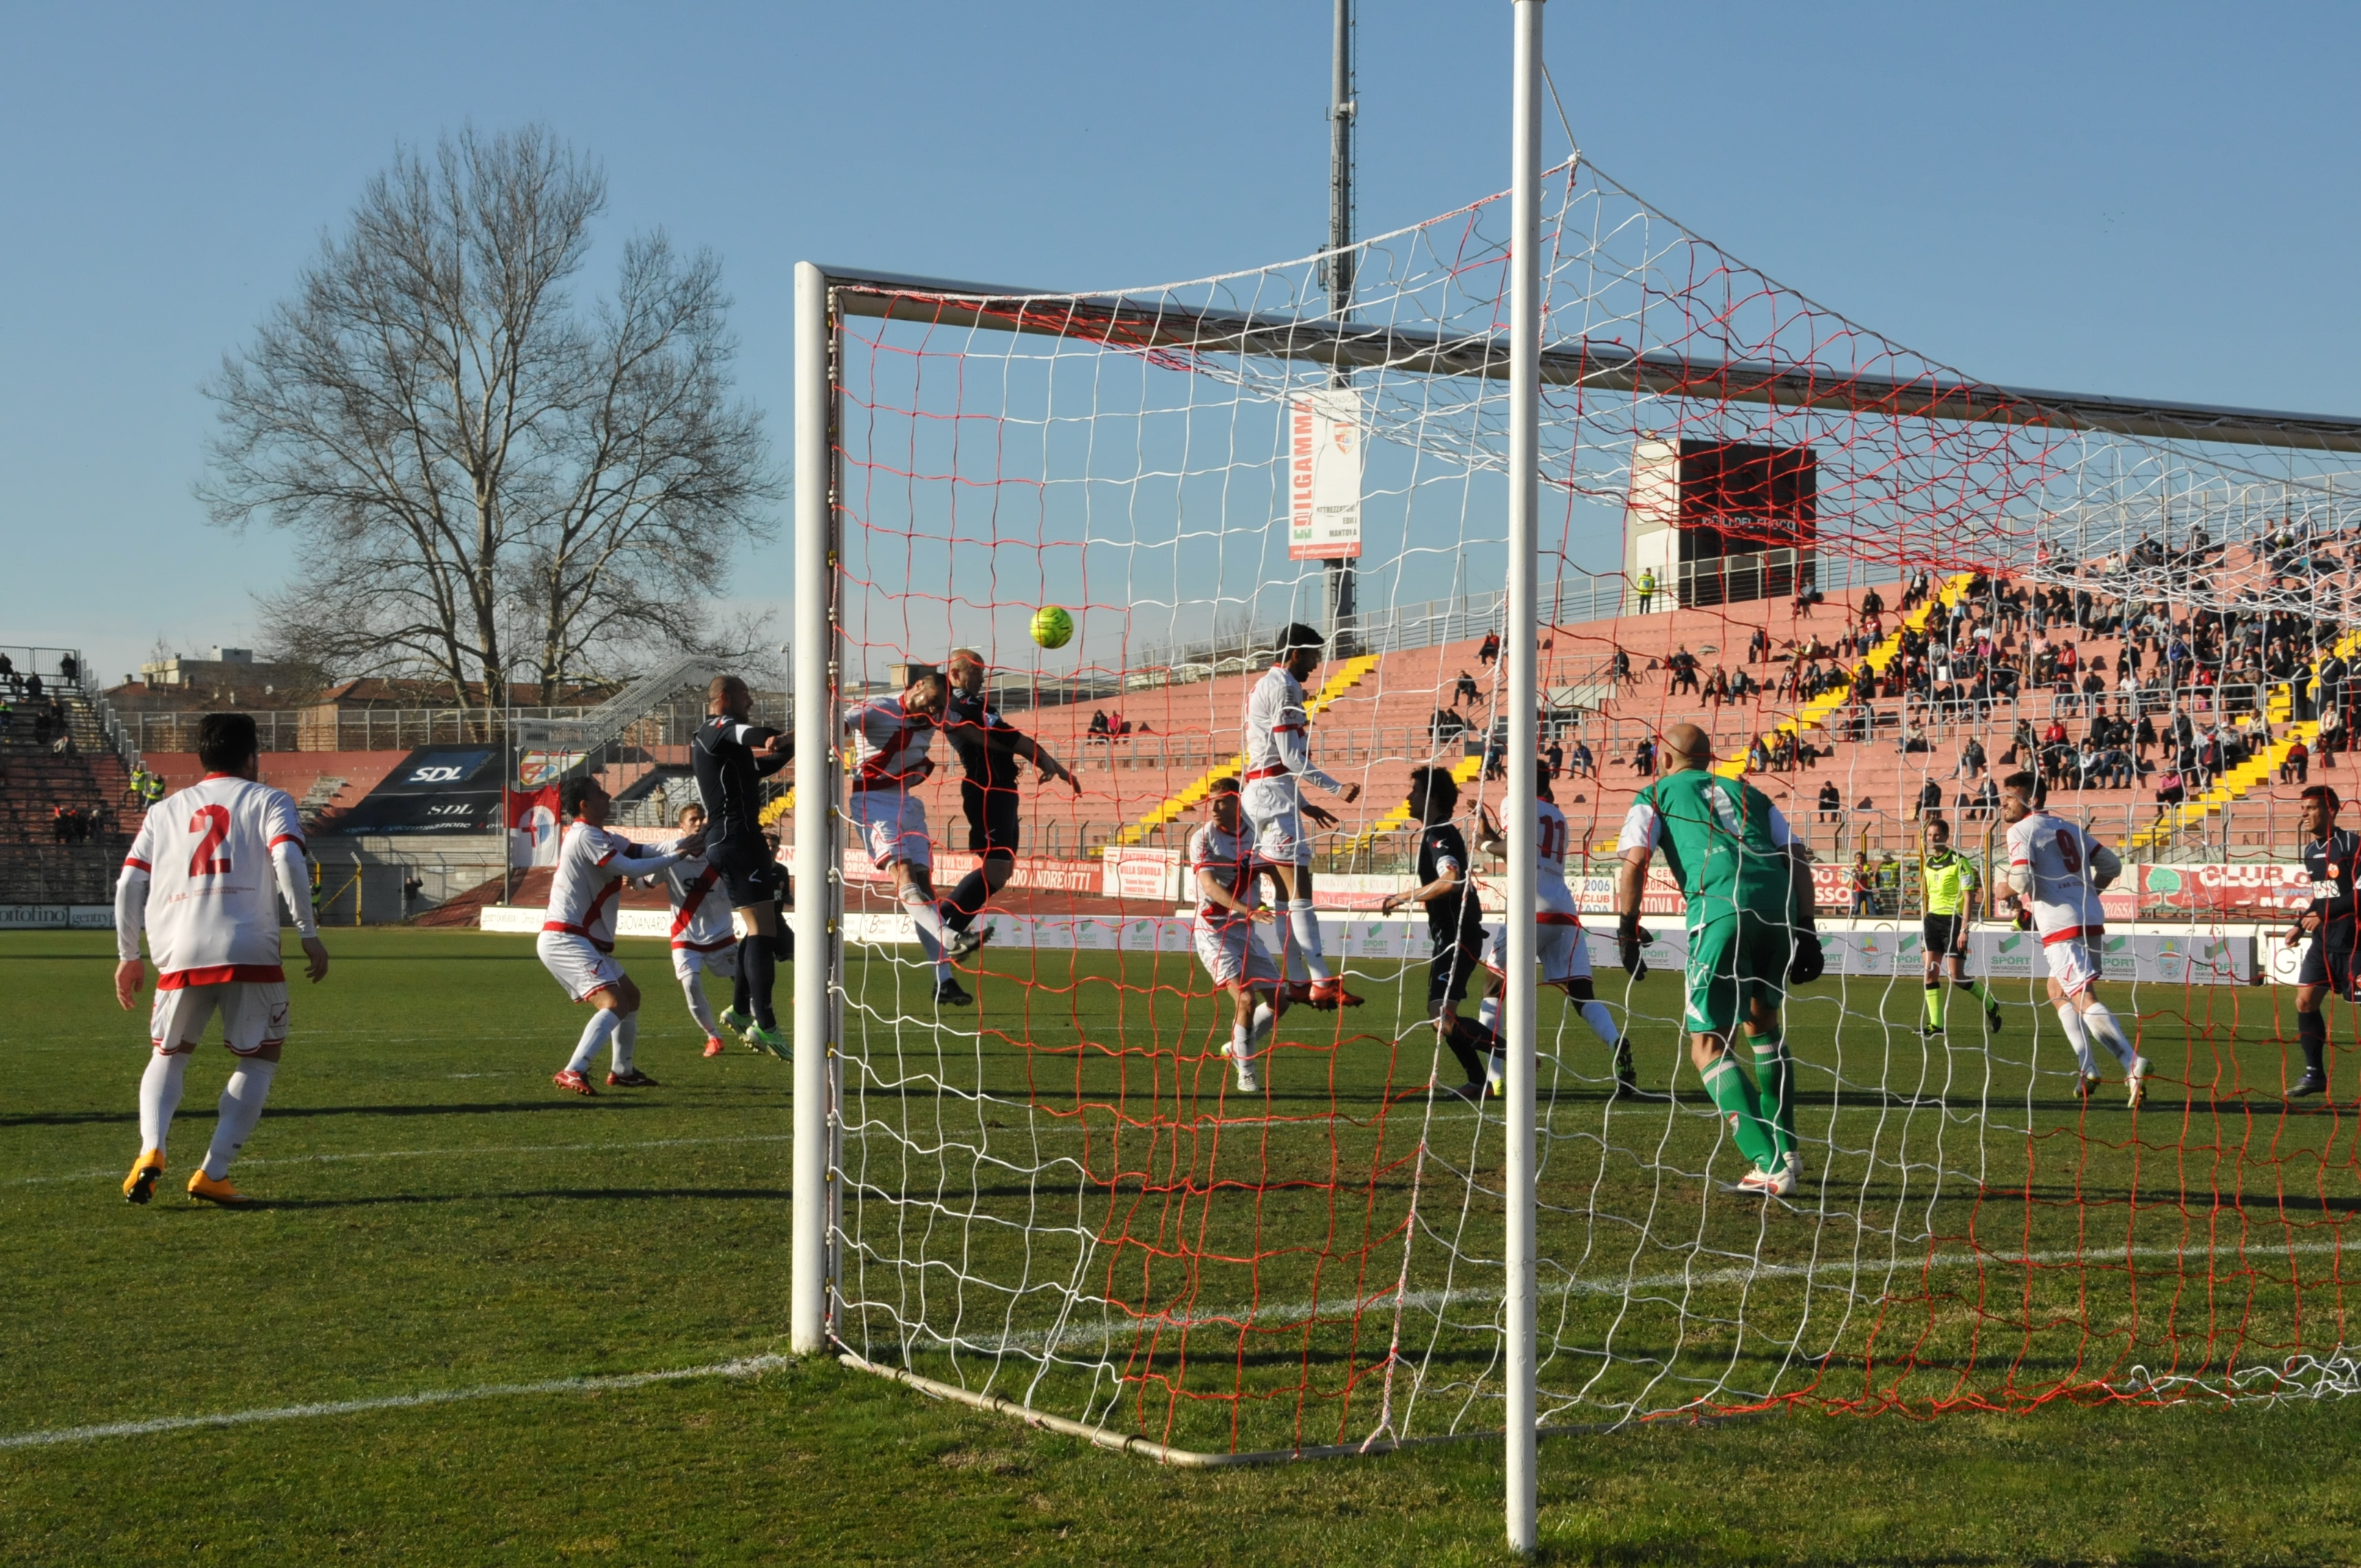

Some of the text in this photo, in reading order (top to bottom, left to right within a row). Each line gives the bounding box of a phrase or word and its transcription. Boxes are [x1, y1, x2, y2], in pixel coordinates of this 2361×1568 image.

[1294, 398, 1312, 539] EDILGAMMA
[1702, 515, 1732, 527] VIGLI
[1330, 528, 1357, 538] MANTOVA
[409, 766, 463, 783] SDL
[427, 803, 475, 816] SDL
[188, 804, 231, 878] 2
[1539, 814, 1565, 865] 11
[844, 850, 868, 863] ONTE
[2056, 829, 2081, 874] 9
[933, 855, 973, 870] NTOVA CLUB
[1120, 865, 1161, 876] VILLA SAVIOLA
[1655, 869, 1675, 878] CEN
[2199, 865, 2284, 888] CLUB
[1029, 869, 1092, 891] ANDREOTTI
[1319, 878, 1393, 889] MANTOVA CLUB
[1585, 879, 1610, 892] 2006
[1582, 893, 1610, 904] CLUB
[1815, 885, 1852, 903] SSO
[0, 906, 65, 922] ortofino
[617, 915, 670, 932] GIOVANARDI
[1824, 953, 1842, 962] ORT
[1990, 956, 2031, 965] SPORT
[2102, 958, 2136, 968] PORT
[2195, 962, 2241, 971] SPORT
